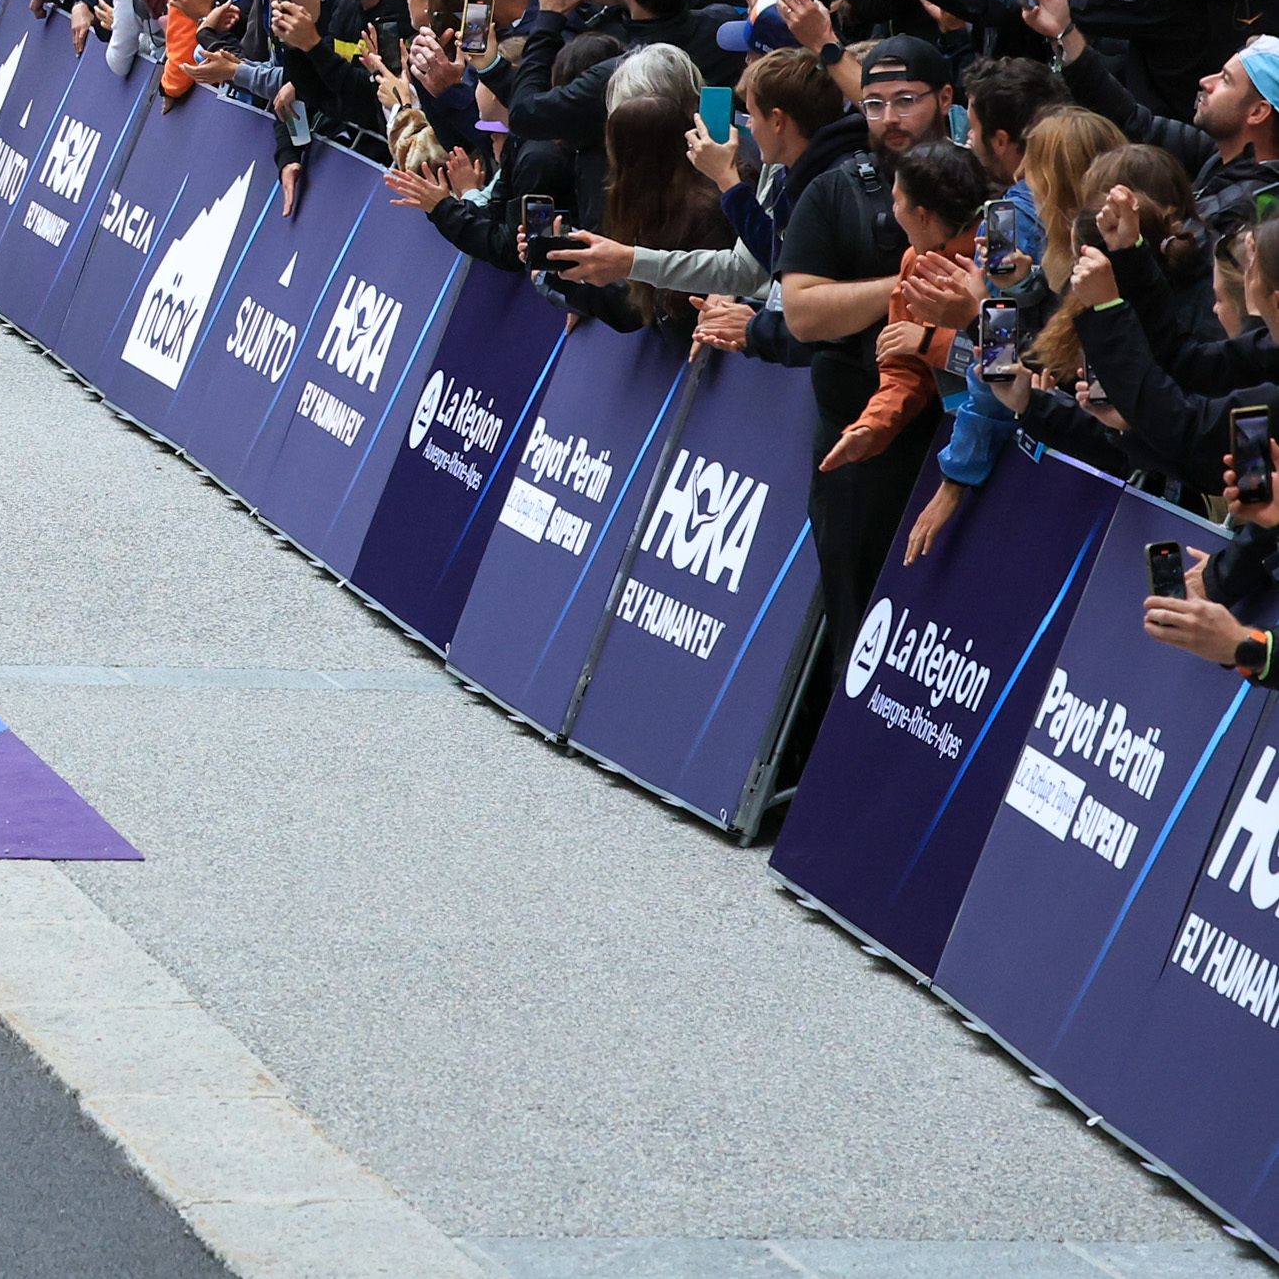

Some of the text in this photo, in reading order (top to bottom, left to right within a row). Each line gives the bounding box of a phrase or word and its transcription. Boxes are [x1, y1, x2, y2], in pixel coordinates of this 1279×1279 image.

[39, 115, 102, 203] HOKA
[137, 272, 199, 363] näak
[226, 296, 297, 383] SUUNTO
[317, 274, 403, 393] HOKA
[297, 381, 321, 418] FLY
[436, 377, 503, 454] La Région
[521, 416, 612, 504] Payot Pertin
[641, 449, 769, 593] HOKA
[616, 578, 726, 660] FLY HUMAN FLY
[884, 607, 991, 712] La Région
[866, 683, 963, 760] Auvergne-Rhône-Alpes
[1034, 667, 1166, 800] Payot Pertin
[1172, 912, 1219, 974] FLY
